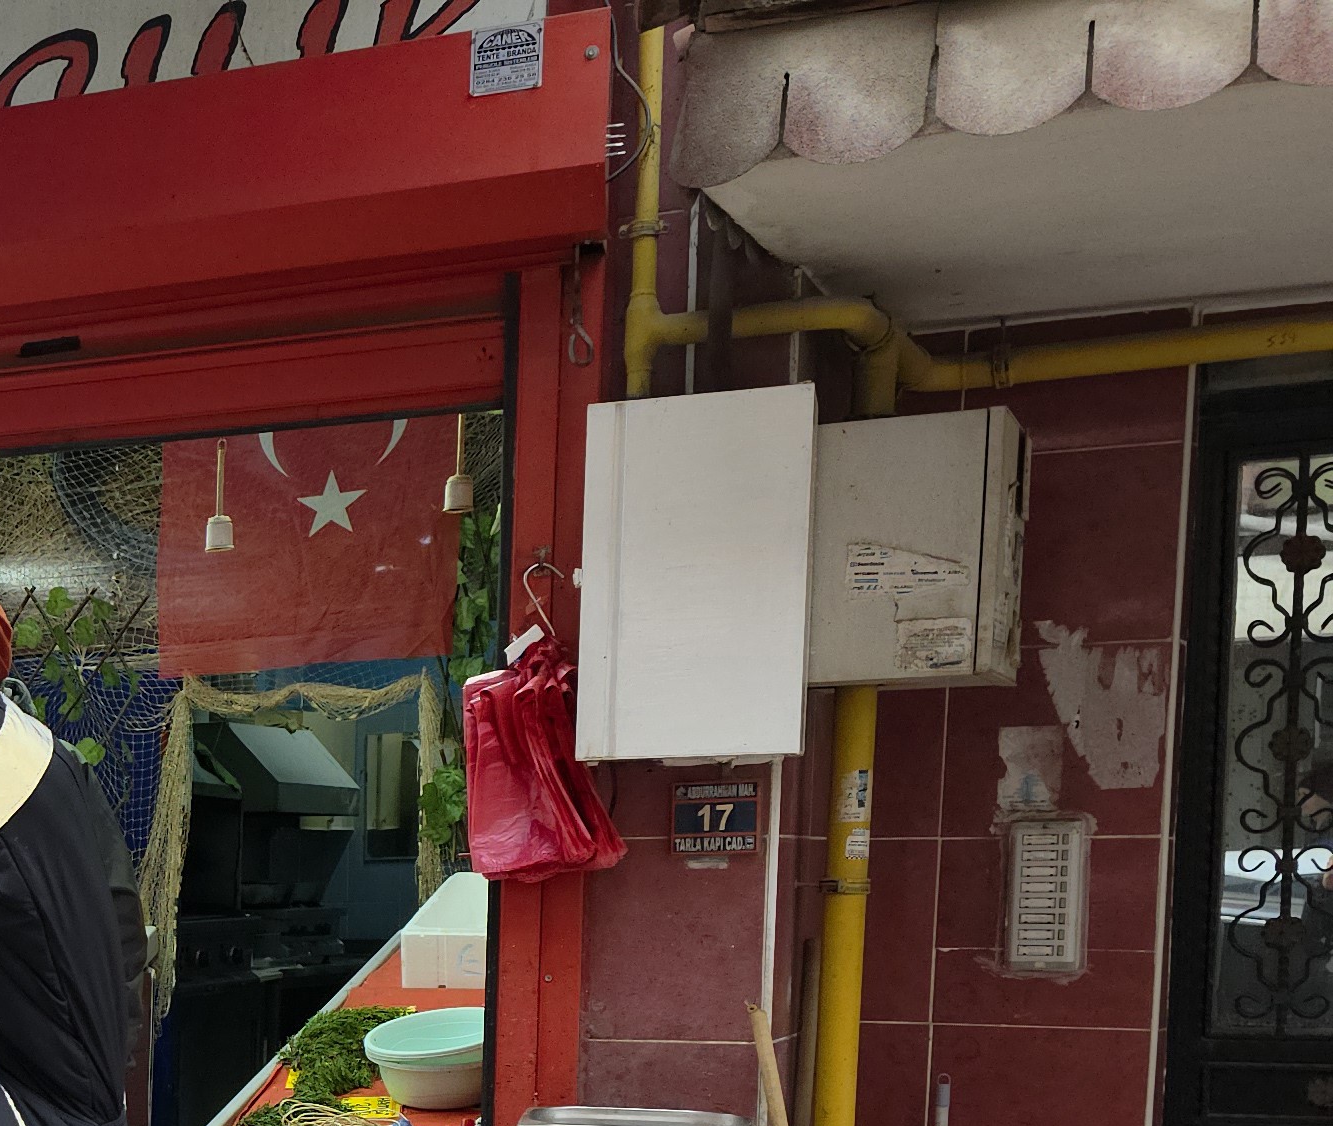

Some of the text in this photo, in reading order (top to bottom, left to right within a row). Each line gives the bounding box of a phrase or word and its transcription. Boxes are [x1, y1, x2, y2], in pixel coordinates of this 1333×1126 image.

[697, 803, 734, 832] 17
[674, 836, 746, 852] TARLA KAPI CAD.
